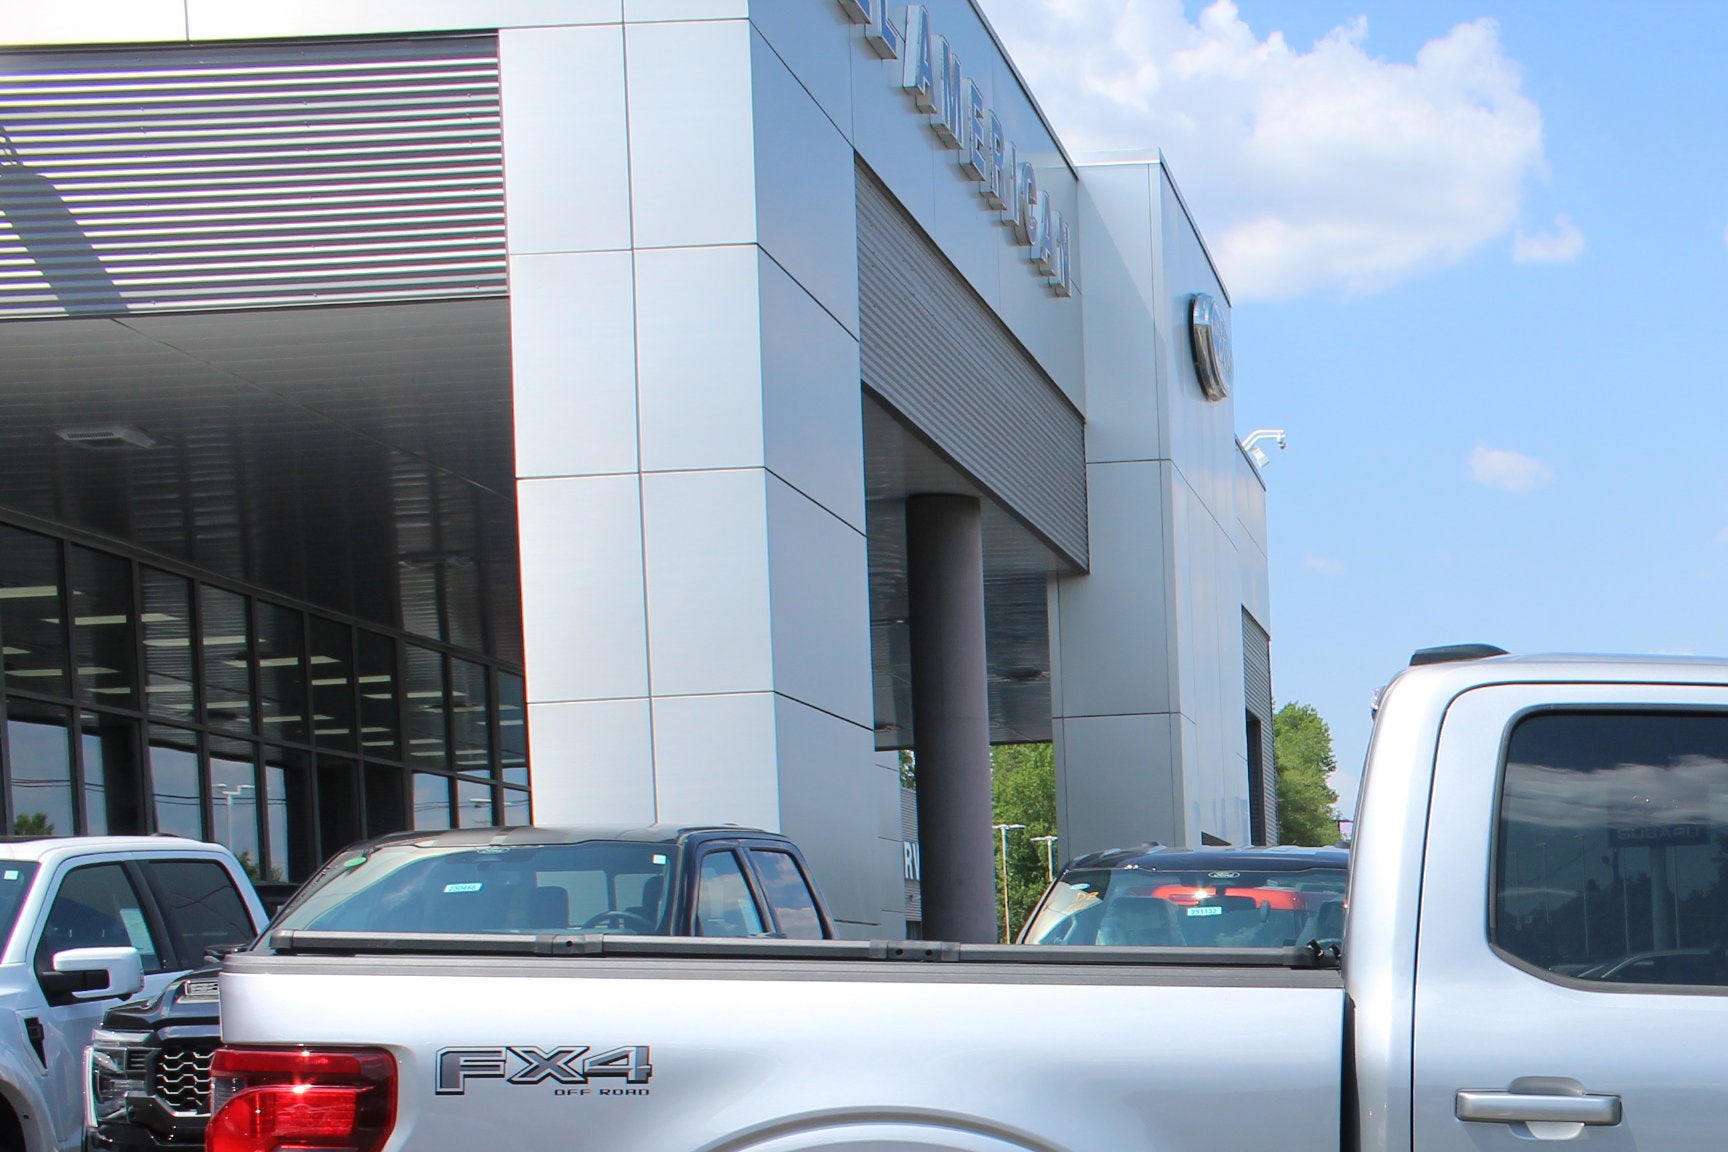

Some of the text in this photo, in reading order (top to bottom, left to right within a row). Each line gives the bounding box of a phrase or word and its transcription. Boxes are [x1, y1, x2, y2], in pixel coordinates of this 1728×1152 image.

[903, 5, 1071, 297] AMERICAN
[1617, 826, 1698, 840] SUBARU
[435, 1046, 652, 1095] FX4
[554, 1088, 650, 1096] OFF ROAD
